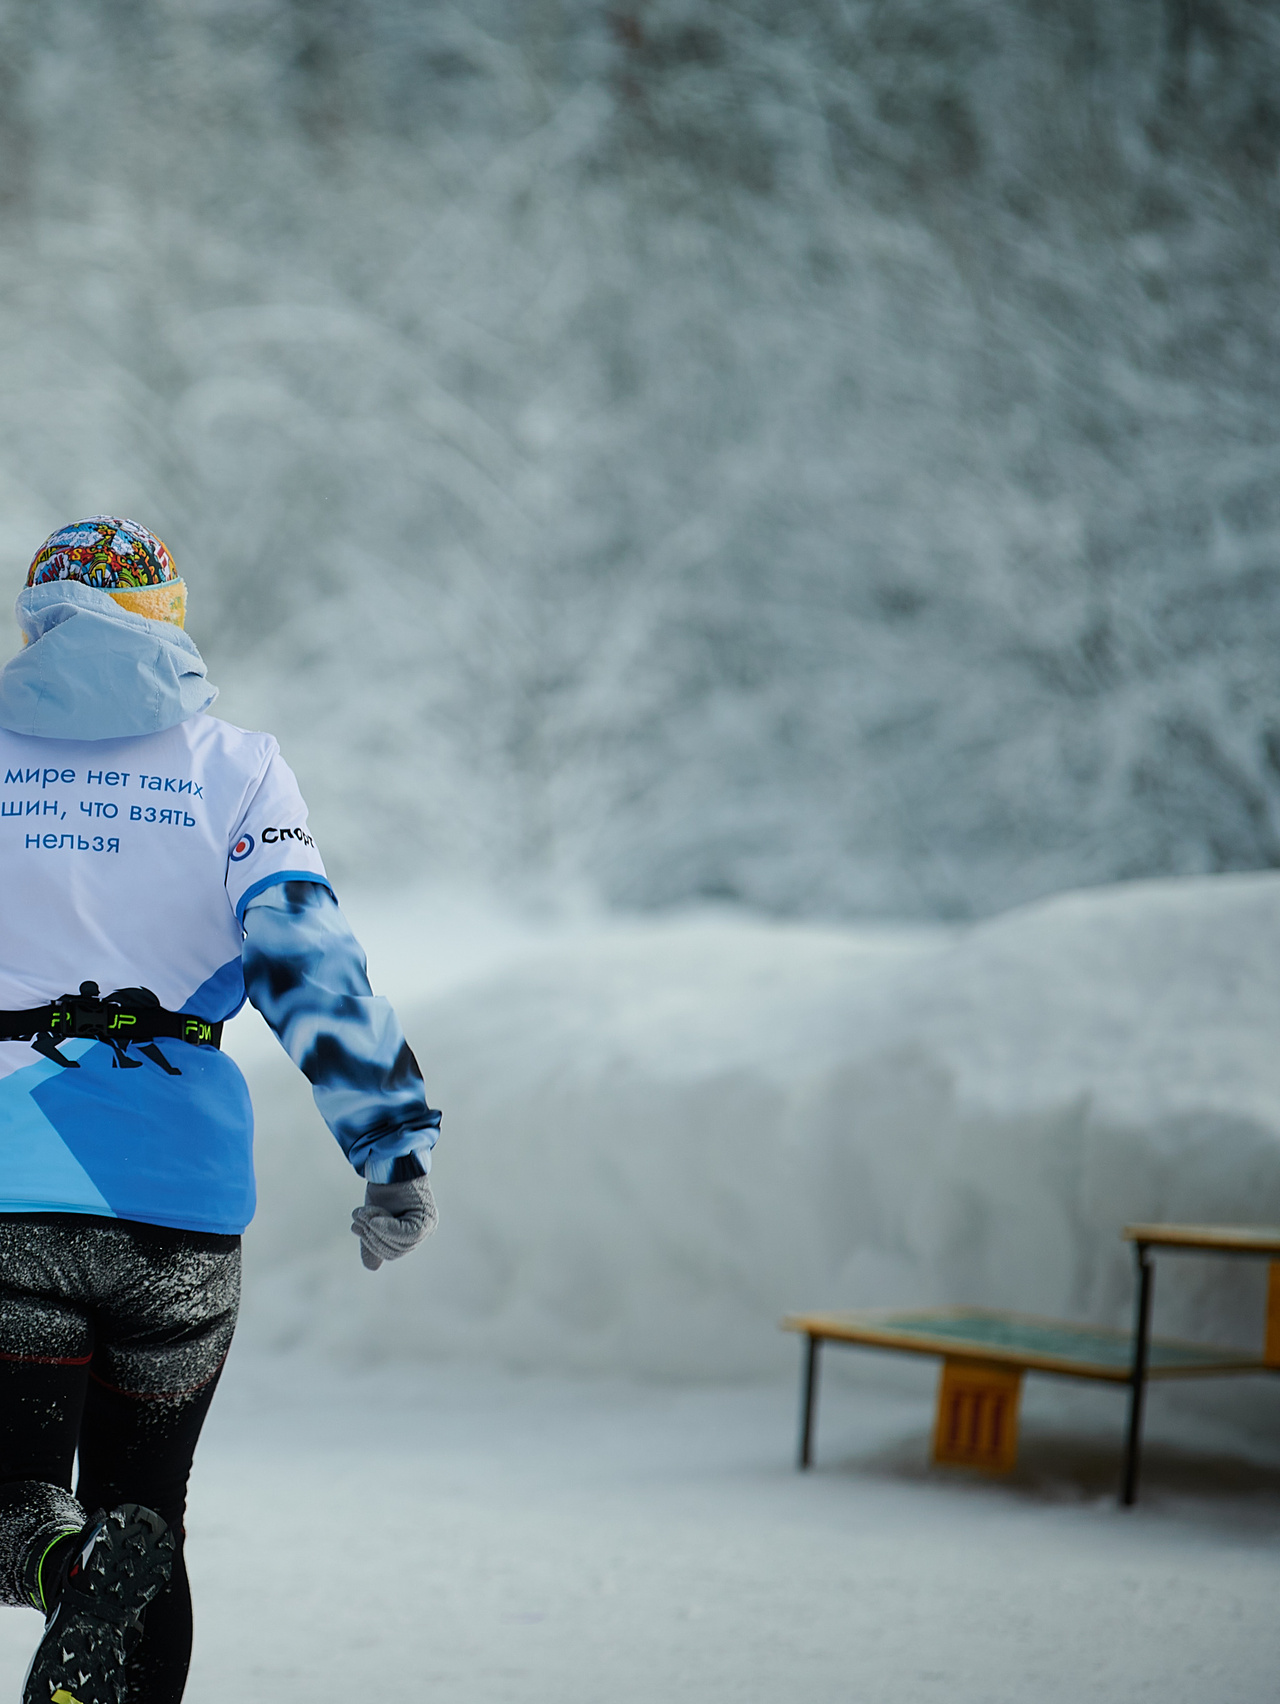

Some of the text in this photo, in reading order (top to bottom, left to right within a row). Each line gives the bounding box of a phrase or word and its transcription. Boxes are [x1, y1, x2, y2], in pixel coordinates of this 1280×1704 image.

[4, 767, 76, 789] мире
[87, 769, 131, 787] нет
[138, 773, 204, 800] таких
[78, 800, 119, 819] что
[128, 805, 197, 828] взять
[24, 832, 120, 854] нельзя
